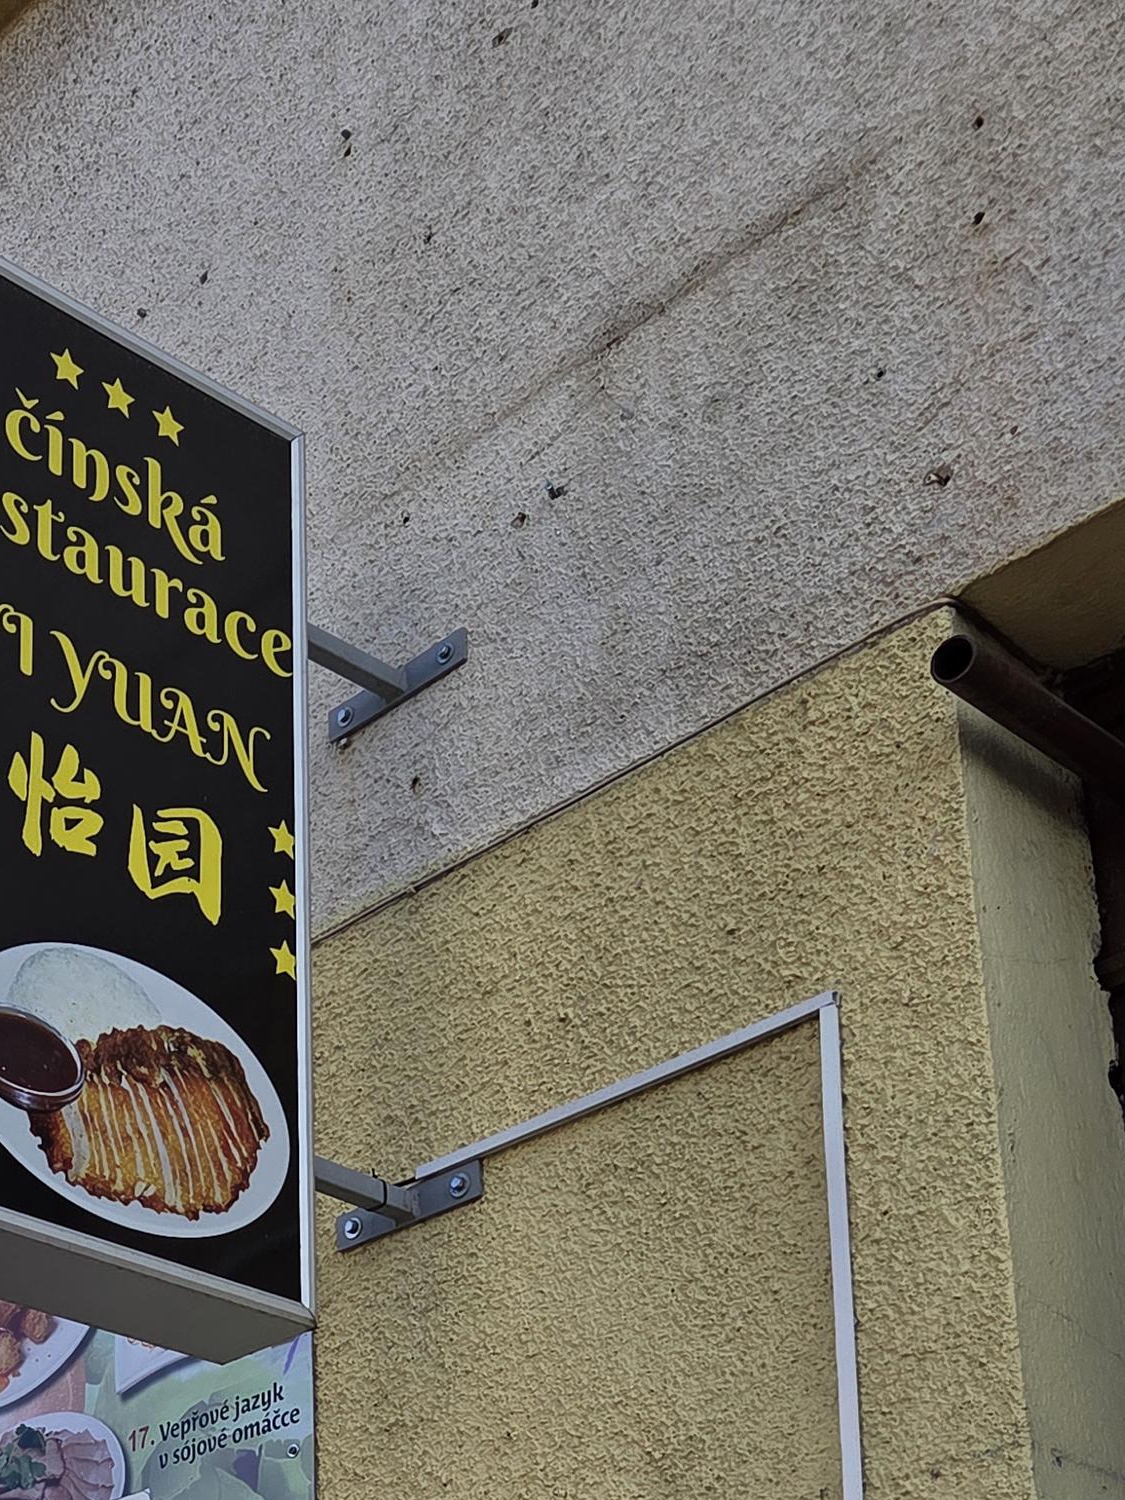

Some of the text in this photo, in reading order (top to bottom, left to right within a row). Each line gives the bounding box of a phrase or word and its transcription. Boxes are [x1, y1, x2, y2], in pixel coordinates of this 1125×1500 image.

[5, 387, 225, 564] čínská
[50, 630, 270, 792] YUAN
[7, 731, 222, 924] 怡园
[128, 1382, 285, 1452] 17. Vepřové jazyk
[158, 1407, 301, 1469] v sójové omáčce
